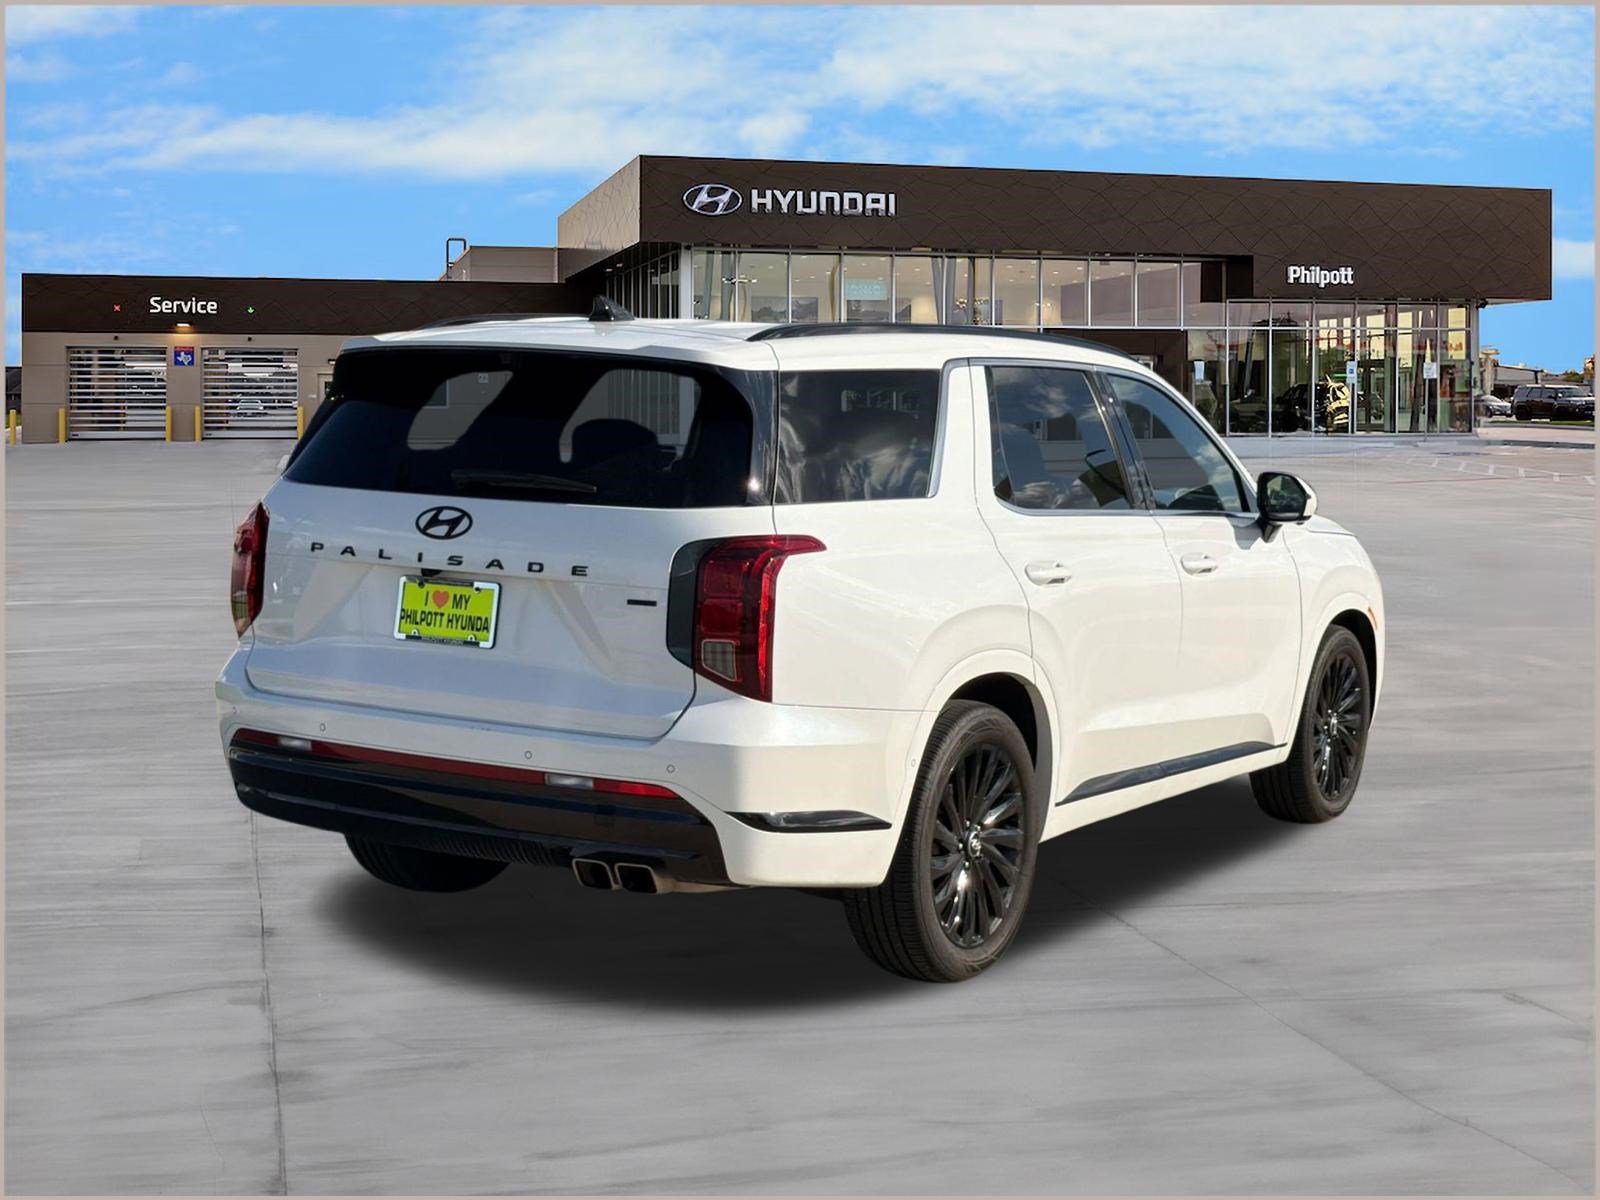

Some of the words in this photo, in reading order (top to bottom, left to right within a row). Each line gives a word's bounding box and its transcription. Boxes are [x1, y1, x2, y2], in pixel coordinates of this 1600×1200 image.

[751, 188, 896, 217] HYUNDAI
[1287, 265, 1355, 288] Philpott
[149, 296, 218, 314] Service
[310, 541, 590, 577] PALISADE
[424, 591, 430, 607] I
[452, 593, 471, 611] MY
[400, 608, 445, 628] PHILPOTT
[446, 612, 490, 633] HYUNDA
